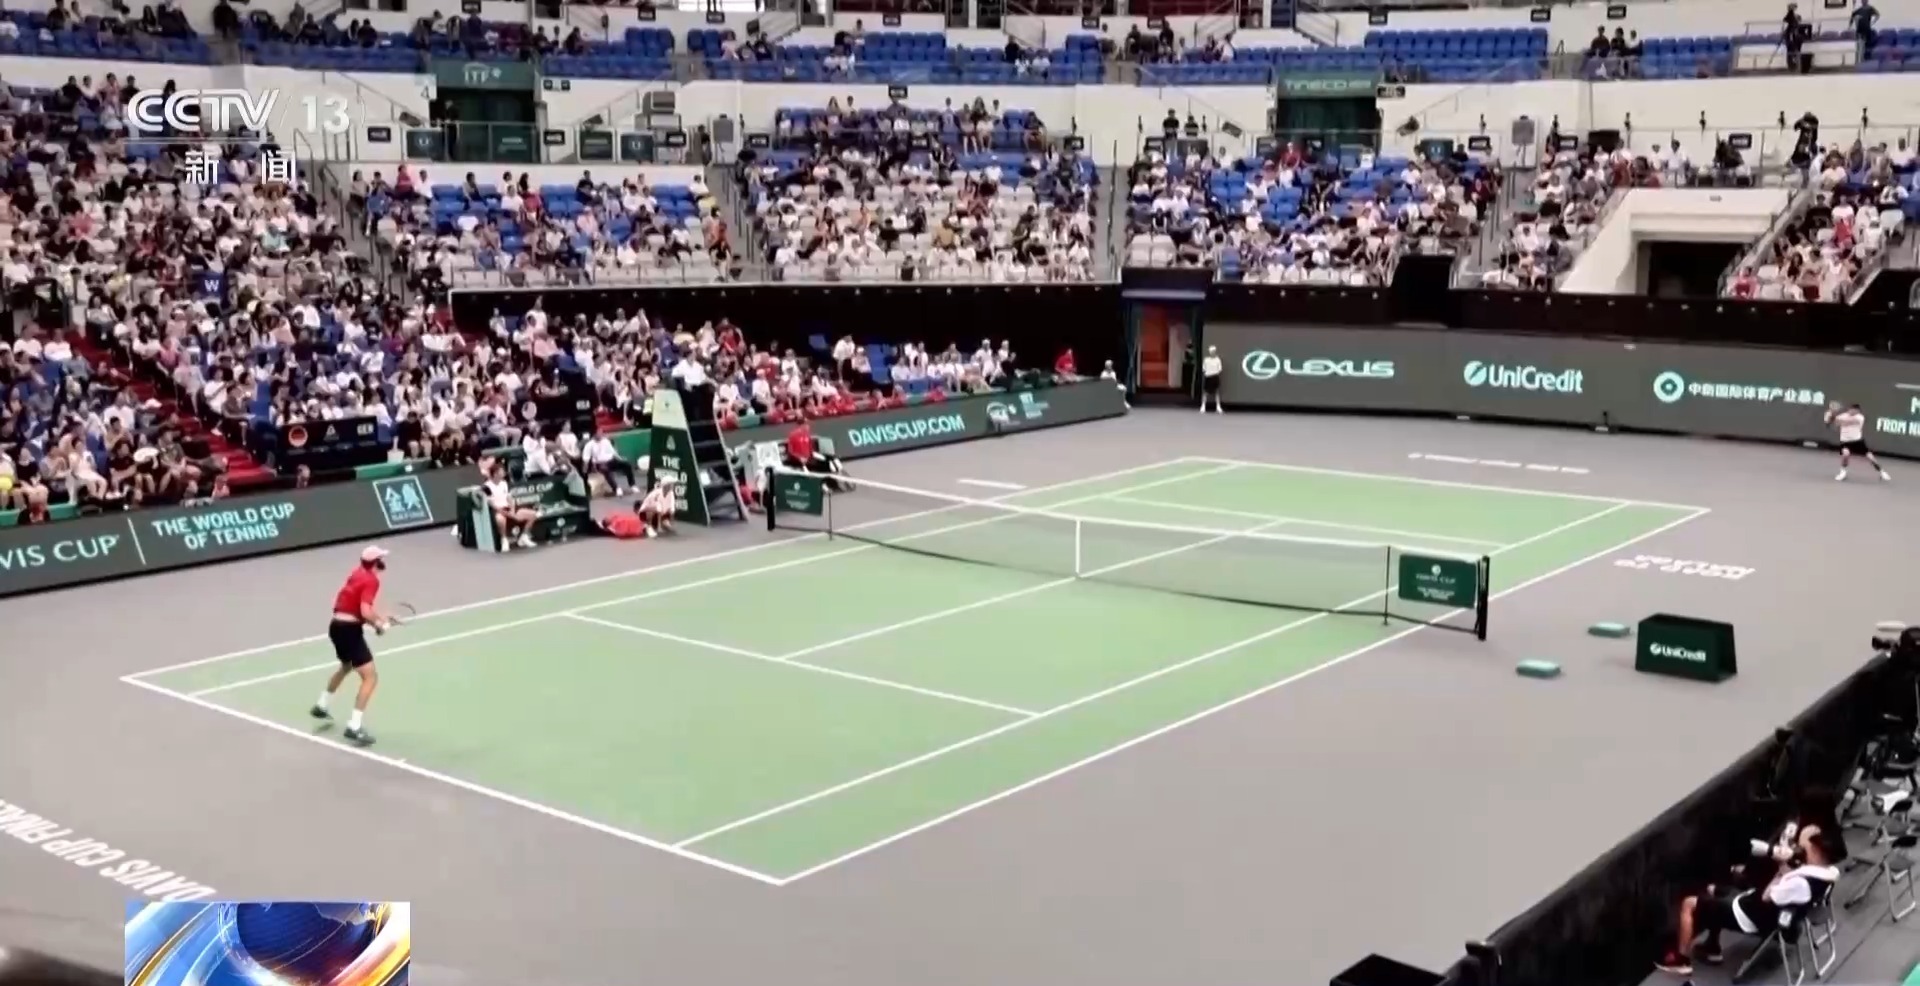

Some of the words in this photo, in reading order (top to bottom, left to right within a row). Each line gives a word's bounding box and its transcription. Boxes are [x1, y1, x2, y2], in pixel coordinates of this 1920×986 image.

[1284, 358, 1394, 378] LEXUS
[1488, 367, 1583, 393] UniCredit
[848, 414, 966, 447] DAVISCUP.COM
[151, 517, 191, 536] THE
[191, 507, 258, 531] WORLD
[260, 502, 295, 521] CUP
[53, 535, 117, 561] CUP
[184, 533, 207, 550] OF
[211, 521, 279, 545] TENNIS
[41, 837, 126, 867] CUP
[99, 859, 217, 903] DAVIS
